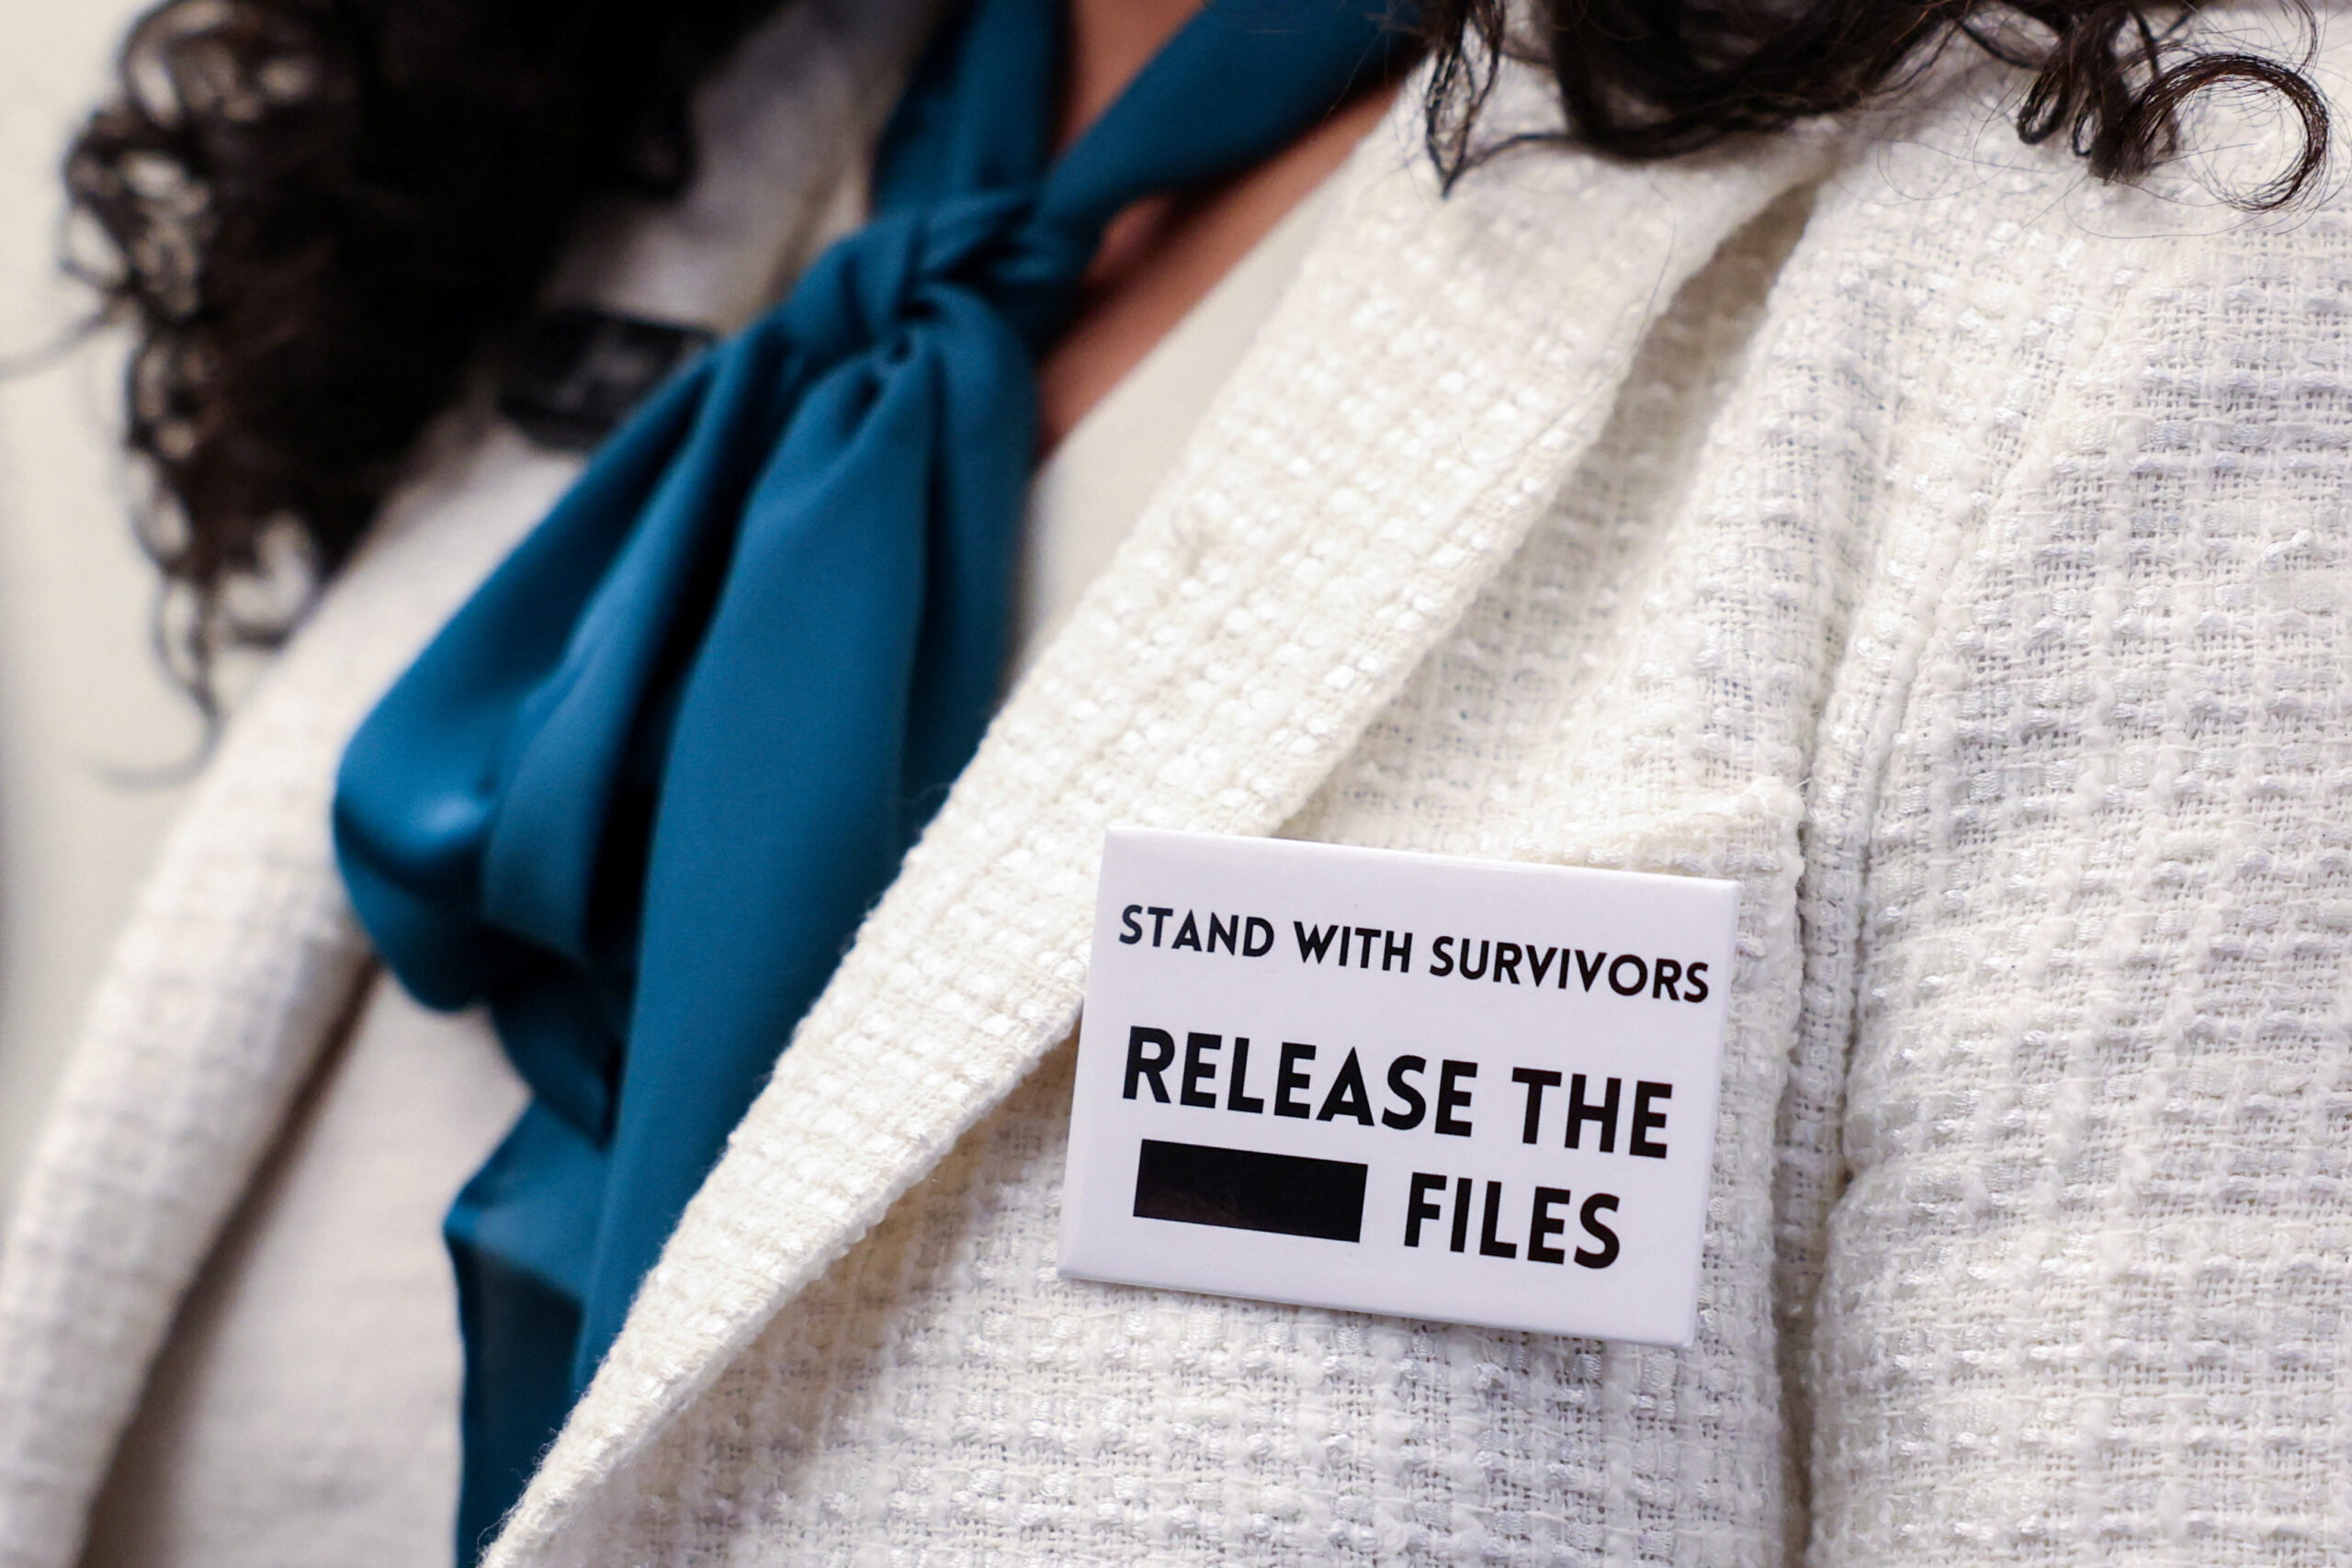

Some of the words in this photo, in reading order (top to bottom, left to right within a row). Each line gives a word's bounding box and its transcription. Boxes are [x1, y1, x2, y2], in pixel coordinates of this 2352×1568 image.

[1120, 905, 1274, 957] STAND
[1294, 921, 1412, 973] WITH
[1430, 935, 1709, 1003] SURVIVORS
[1123, 1026, 1478, 1137] RELEASE
[1512, 1066, 1673, 1159] THE
[1404, 1172, 1621, 1269] FILES
